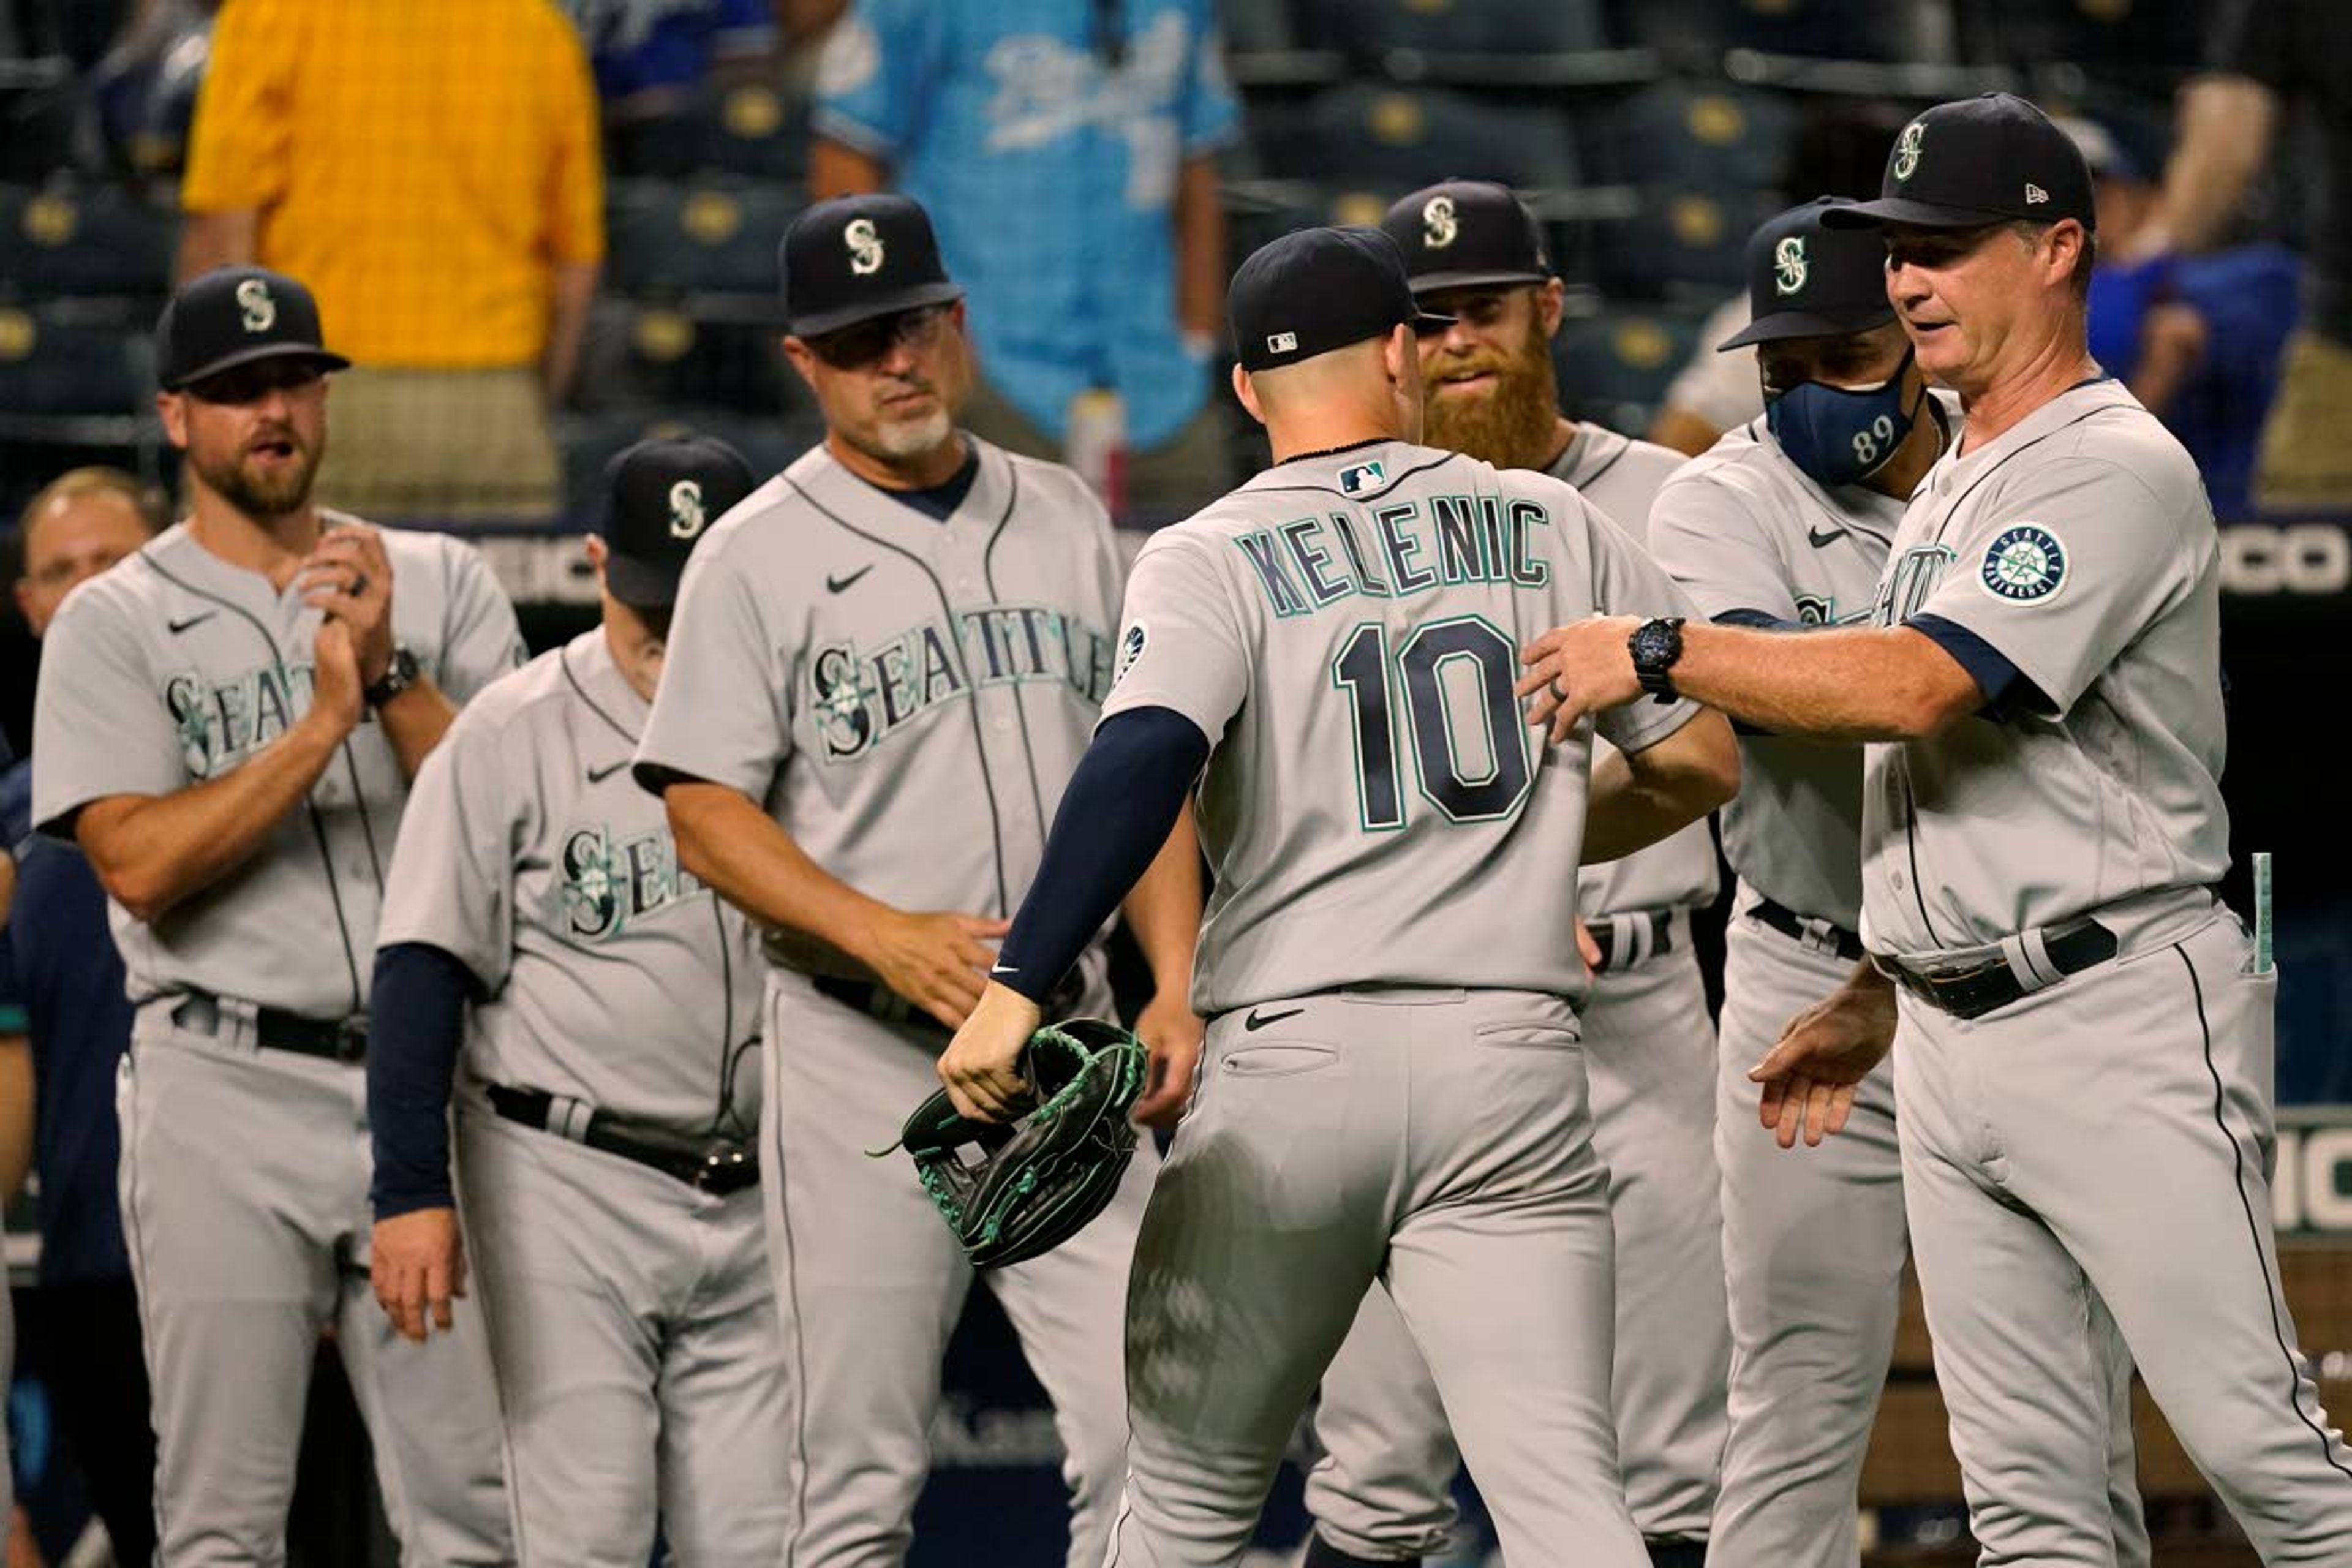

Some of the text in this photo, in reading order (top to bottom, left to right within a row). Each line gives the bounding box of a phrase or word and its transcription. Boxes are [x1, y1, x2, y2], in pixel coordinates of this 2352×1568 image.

[1894, 123, 1928, 179] S
[844, 218, 884, 274] S
[1423, 195, 1462, 248] S
[1774, 235, 1810, 295] S
[236, 279, 276, 332] S
[1851, 414, 1896, 465] 89
[669, 479, 707, 539] S
[1233, 495, 1550, 619] KELENIC
[2000, 529, 2060, 572] SEATTLE
[1332, 613, 1532, 832] 10
